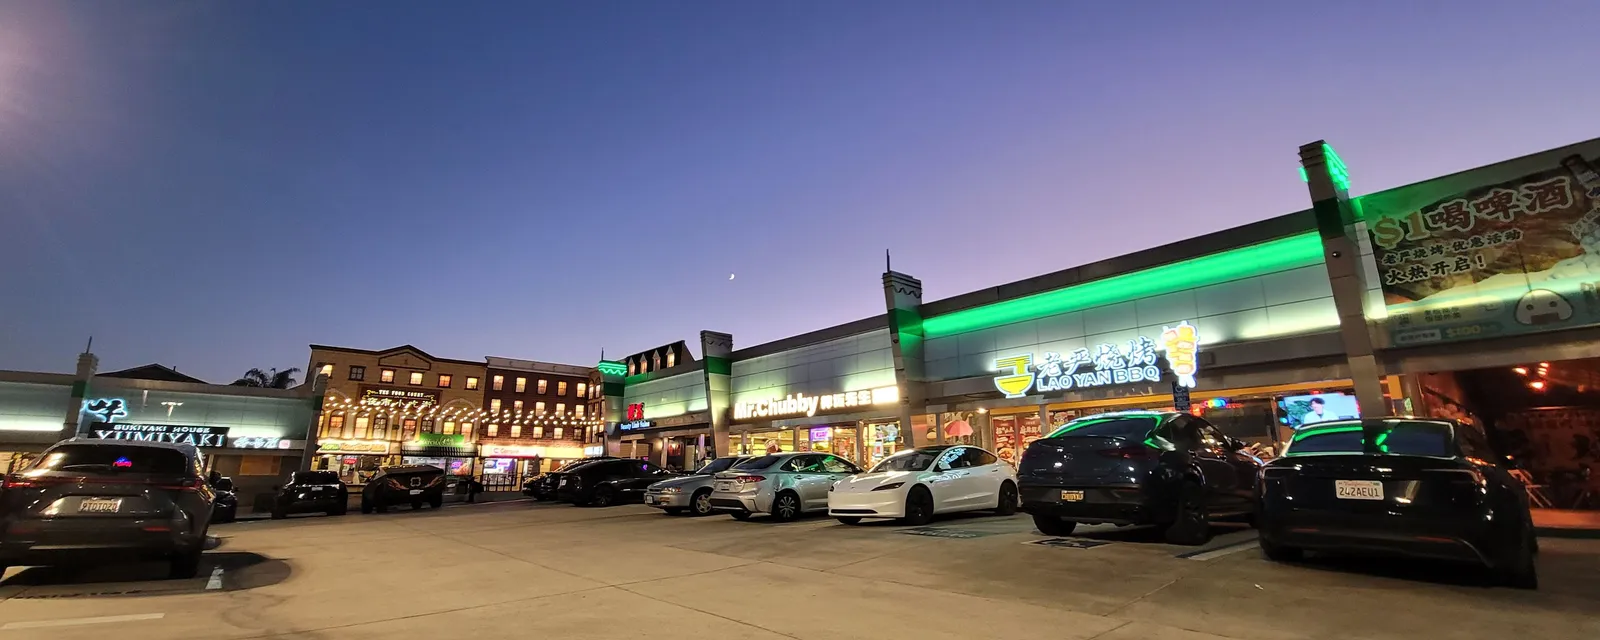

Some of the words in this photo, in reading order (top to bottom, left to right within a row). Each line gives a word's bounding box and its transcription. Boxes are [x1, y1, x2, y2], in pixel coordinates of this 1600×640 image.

[1374, 176, 1573, 249] $1喝啤酒
[1036, 336, 1158, 379] 老严烧烤
[1036, 375, 1073, 392] LAO
[1073, 369, 1113, 387] YAN
[1113, 365, 1160, 383] BBQ
[733, 392, 819, 420] Mr.Chubby
[113, 424, 167, 432] SUKIYAKI
[172, 426, 210, 434] HOUSE
[1339, 486, 1380, 497] 242AEU1
